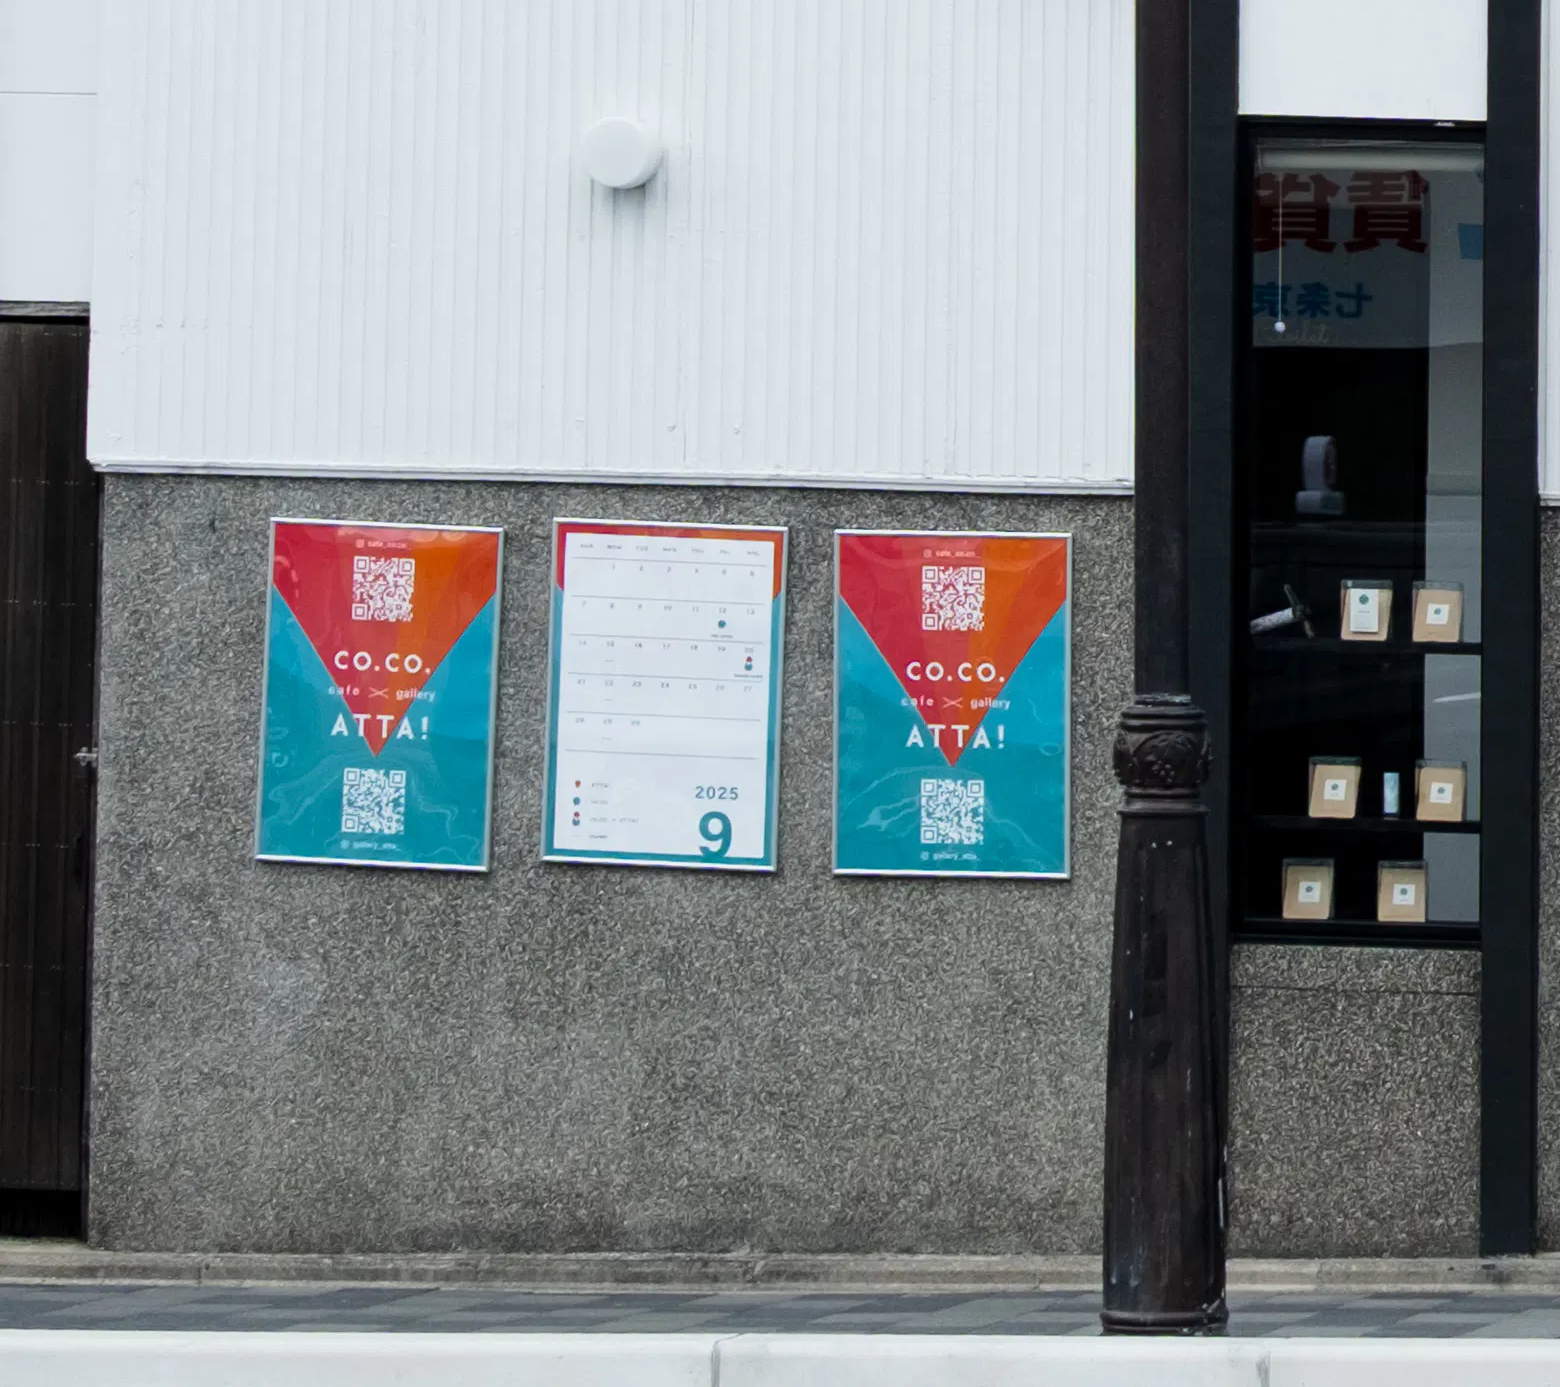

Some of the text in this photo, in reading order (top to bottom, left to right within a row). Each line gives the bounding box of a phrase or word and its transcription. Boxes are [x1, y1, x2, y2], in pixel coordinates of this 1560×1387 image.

[333, 650, 432, 676] CO.CO.
[905, 660, 1006, 684] CO.CO.
[327, 684, 361, 697] cafe
[395, 688, 437, 703] gallery
[901, 695, 934, 708] cafe
[970, 697, 1011, 711] gallery
[330, 712, 429, 740] ATTA!
[905, 723, 1006, 750] ATTA!
[694, 785, 740, 801] 2025
[698, 811, 733, 859] 9
